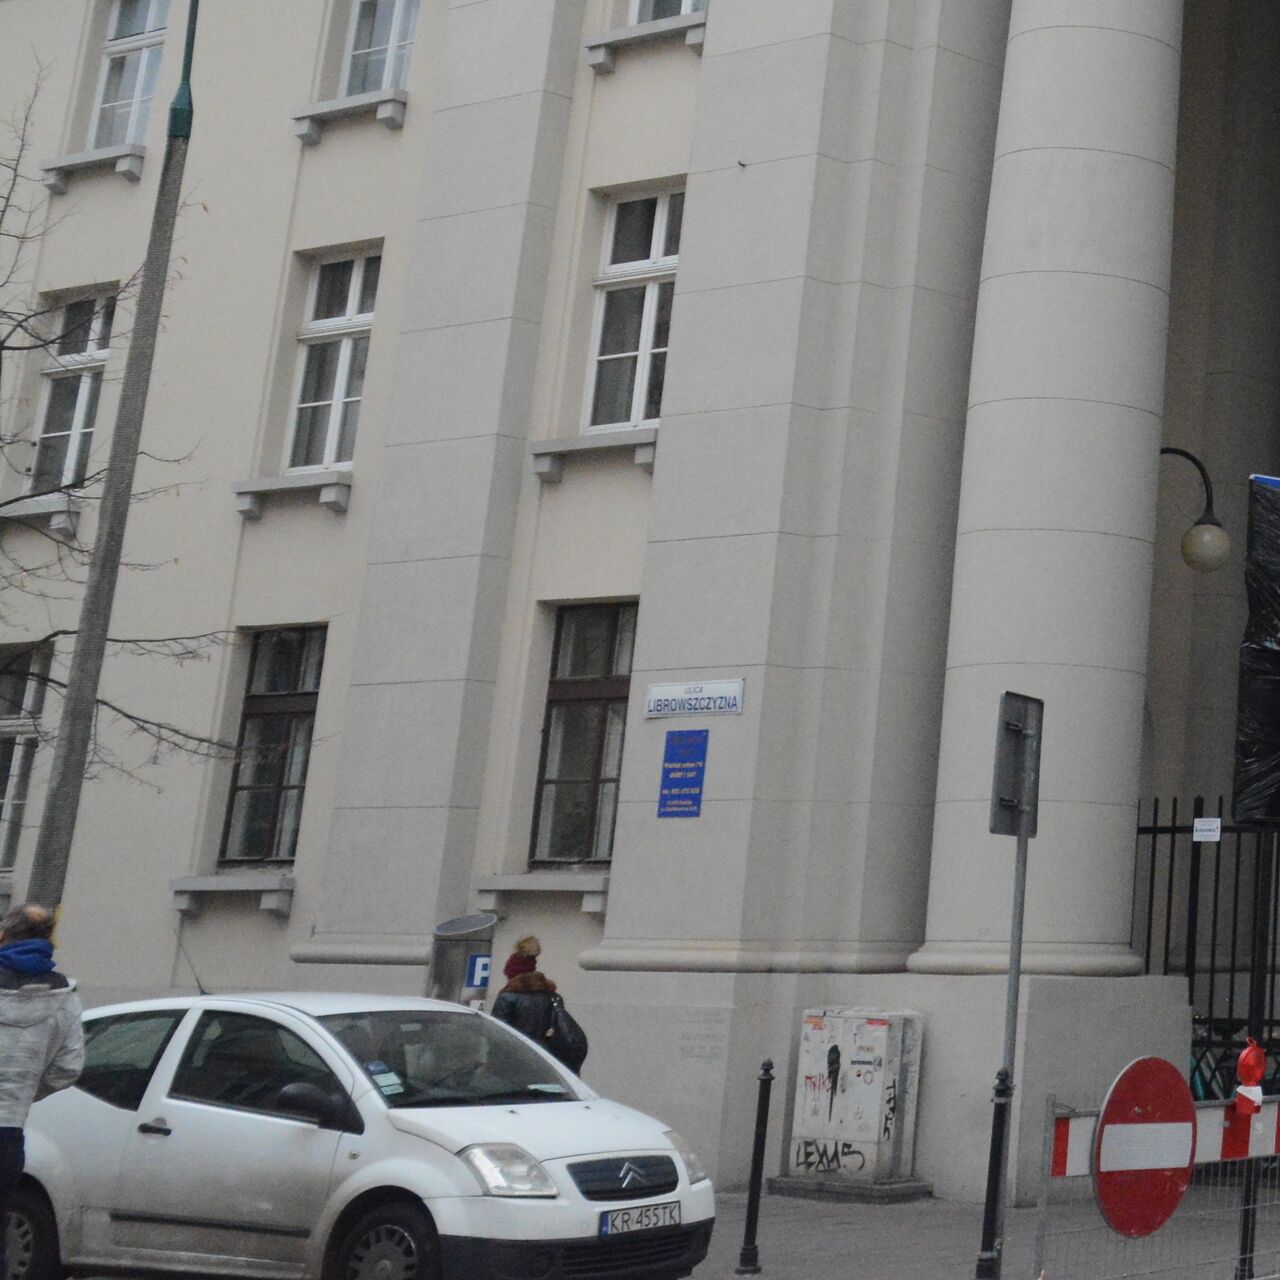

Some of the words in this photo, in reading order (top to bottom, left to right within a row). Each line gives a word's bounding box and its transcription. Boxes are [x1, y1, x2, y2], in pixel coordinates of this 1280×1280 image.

[648, 696, 738, 713] LIBROWSZCZYZNA
[611, 1211, 631, 1233] KR
[635, 1203, 677, 1228] 455TK
